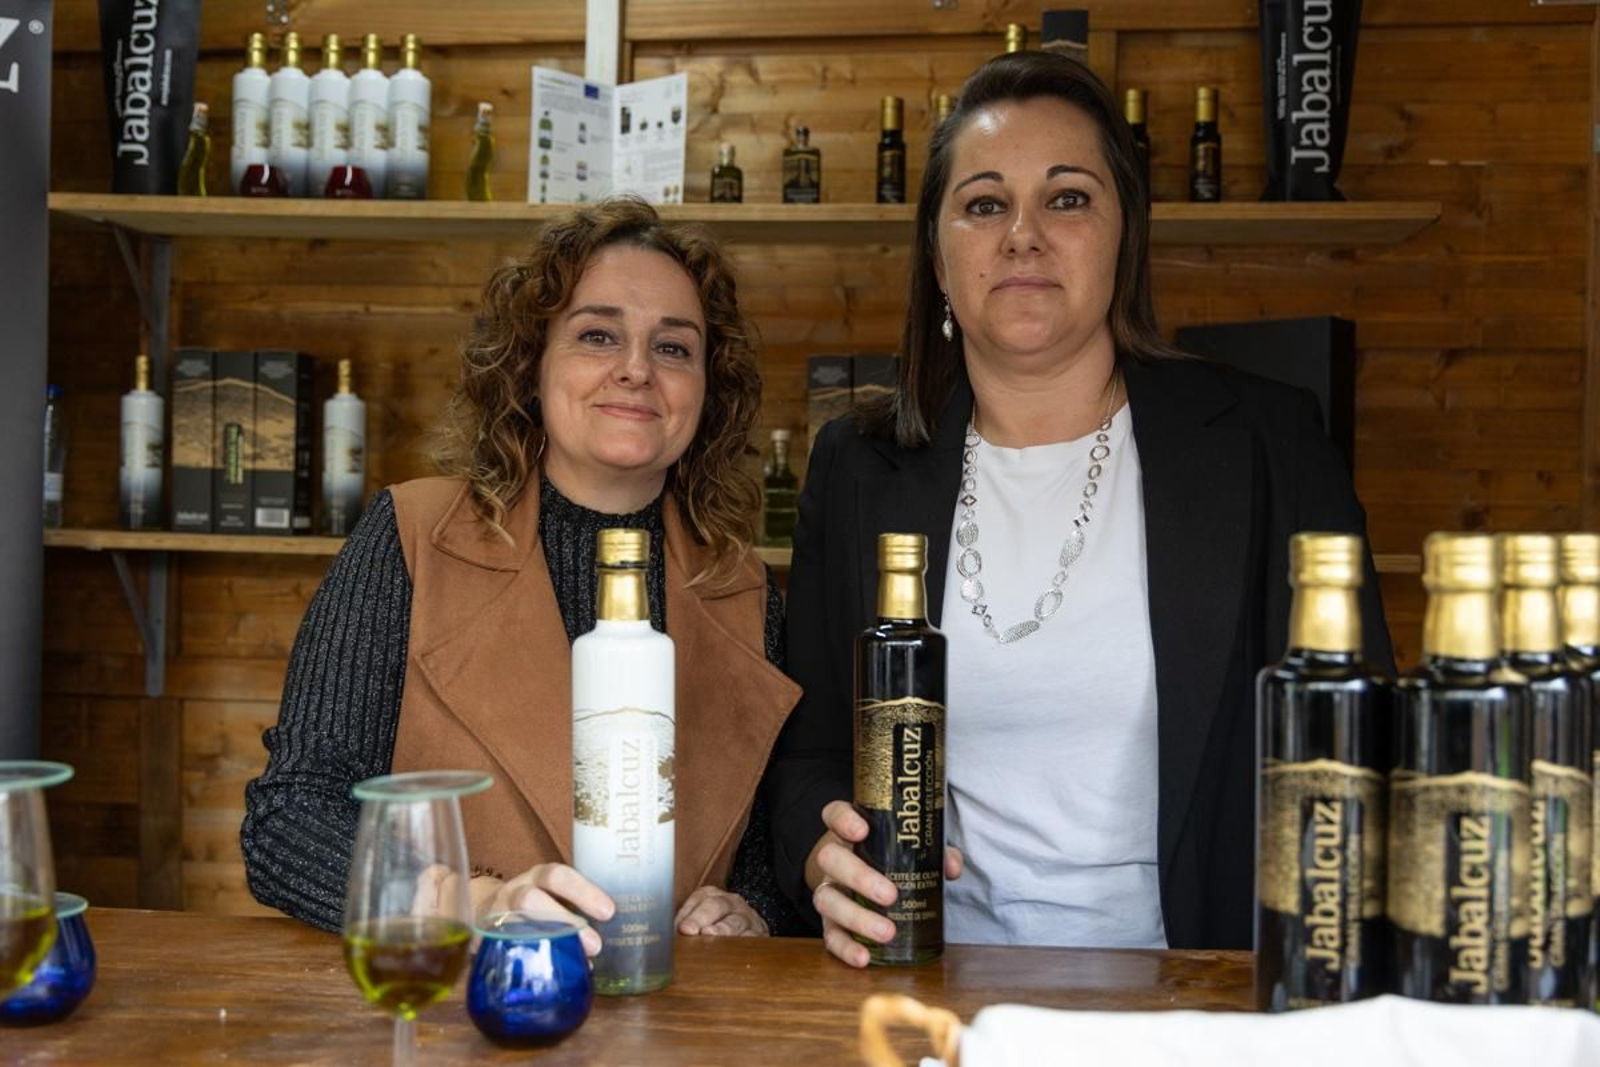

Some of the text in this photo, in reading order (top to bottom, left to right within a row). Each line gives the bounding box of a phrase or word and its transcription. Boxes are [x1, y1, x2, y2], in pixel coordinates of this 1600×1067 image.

[615, 739, 640, 865] Jabalcuz
[896, 726, 922, 849] Jabalcuz
[925, 750, 934, 847] GRAN SELECCIÓN
[901, 899, 926, 909] 500ml
[1304, 801, 1342, 971] Jabalcuz
[1449, 816, 1491, 994] Jabalcuz
